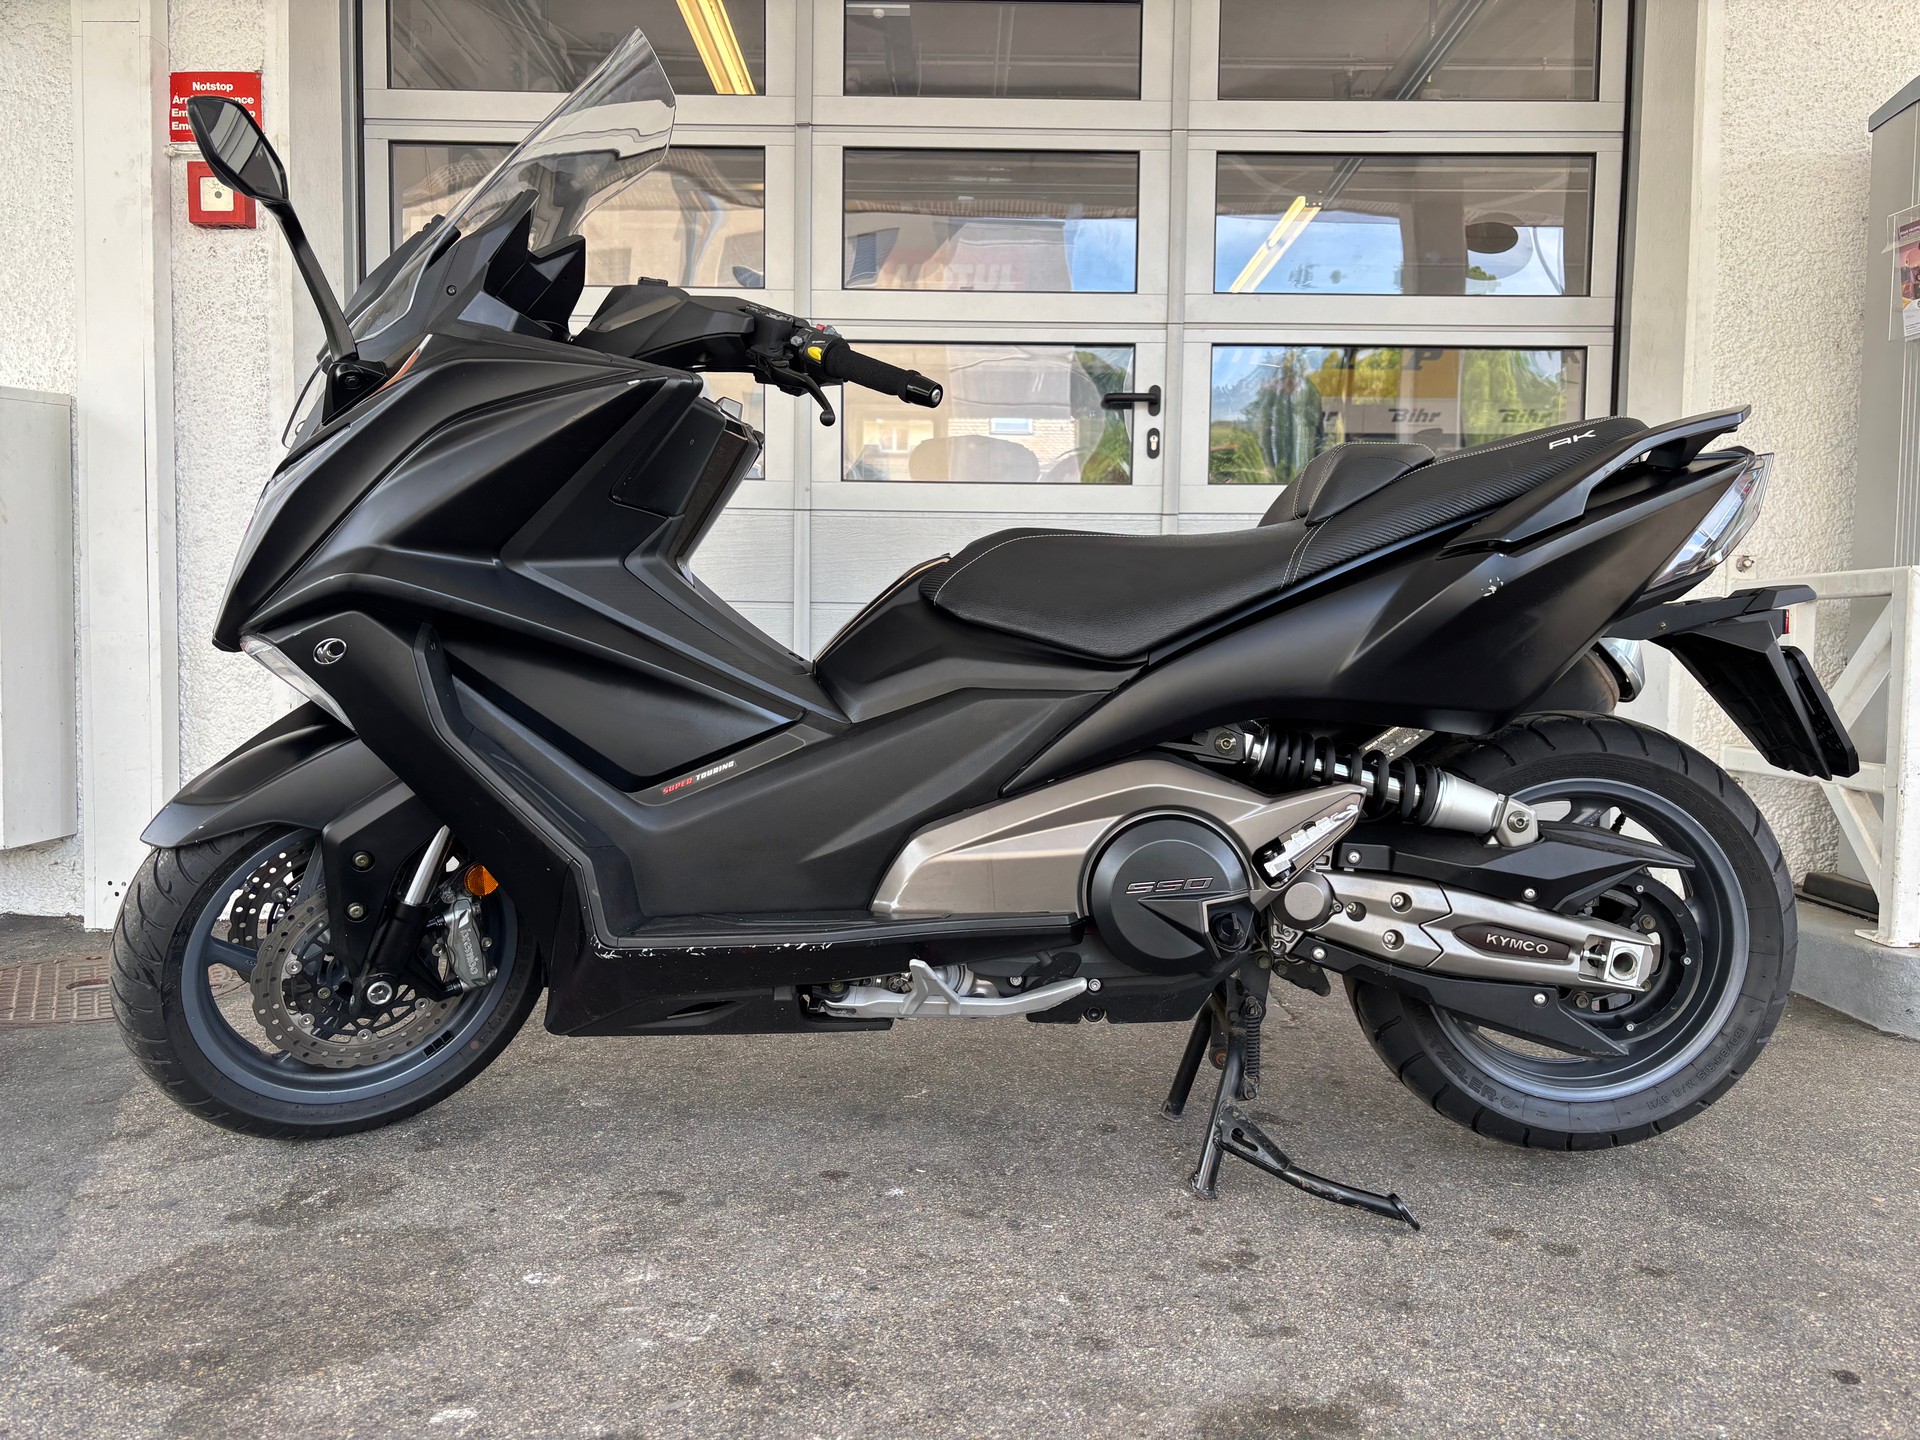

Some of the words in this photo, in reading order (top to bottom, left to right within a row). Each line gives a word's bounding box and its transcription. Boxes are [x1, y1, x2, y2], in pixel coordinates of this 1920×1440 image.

[192, 81, 234, 92] Notstop
[1388, 407, 1441, 423] Bihr
[1498, 408, 1552, 424] Bihr
[662, 777, 693, 795] SUPER
[695, 760, 735, 781] TOURING
[460, 928, 479, 975] brembo
[1486, 933, 1549, 954] KYMCO
